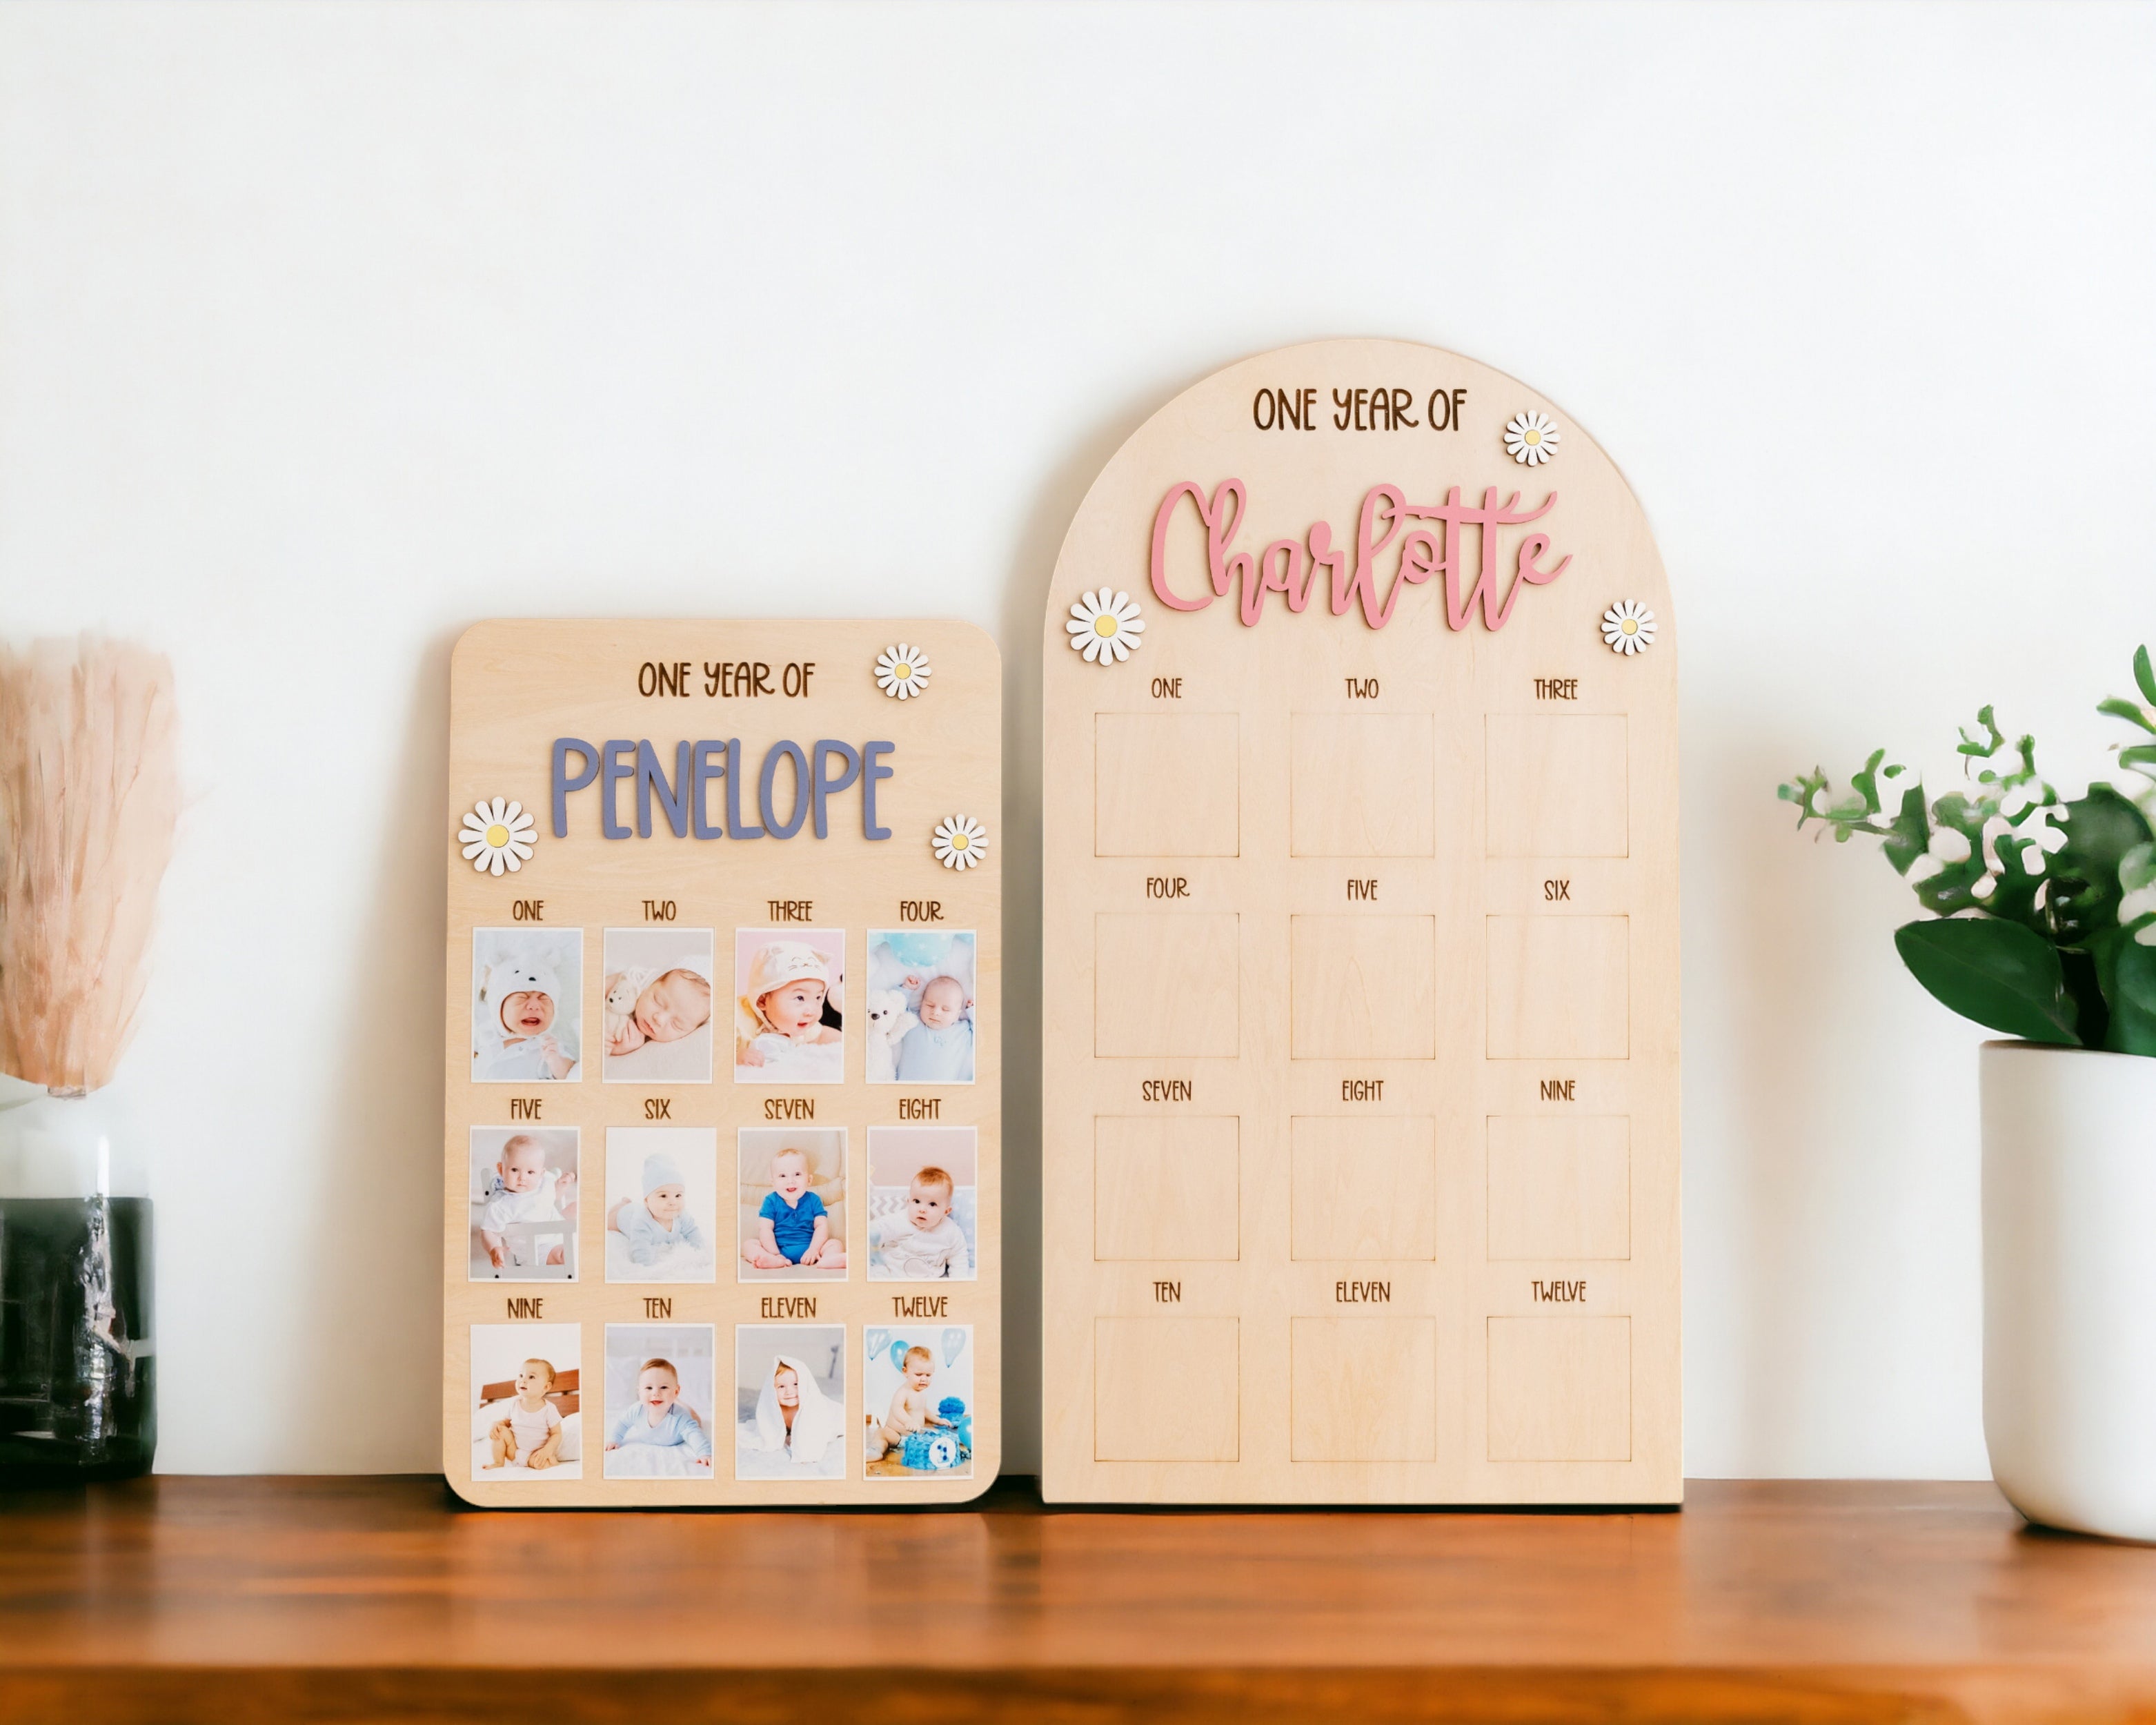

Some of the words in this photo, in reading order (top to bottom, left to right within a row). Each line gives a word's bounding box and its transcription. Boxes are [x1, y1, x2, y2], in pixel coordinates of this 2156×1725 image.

[1253, 388, 1317, 431] ONE
[1332, 387, 1420, 431] YEAR
[1427, 388, 1467, 432] OF
[1150, 477, 1573, 633] Charlotte
[637, 662, 692, 698] ONE
[703, 661, 775, 698] YEAR
[782, 662, 816, 698] OF
[1151, 678, 1183, 699] ONE
[1345, 678, 1379, 699] TWO
[1533, 678, 1579, 700] THREE
[552, 737, 896, 840] PENELOPE
[1147, 877, 1190, 899] FOUR
[1347, 879, 1378, 900] FIVE
[1543, 880, 1570, 901] SIX
[512, 900, 544, 921] ONE
[641, 900, 677, 921] TWO
[767, 900, 813, 922] THREE
[900, 900, 945, 922] FOUR
[1142, 1080, 1191, 1102] SEVEN
[1342, 1080, 1384, 1101] EIGHT
[1540, 1080, 1576, 1101] NINE
[511, 1098, 542, 1120] FIVE
[644, 1098, 671, 1120] SIX
[764, 1098, 815, 1120] SEVEN
[899, 1098, 942, 1120] EIGHT
[1152, 1281, 1181, 1303] TEN
[1336, 1281, 1391, 1303] ELEVEN
[1531, 1280, 1587, 1302] TWELVE
[507, 1297, 544, 1319] NINE
[642, 1297, 672, 1319] TEN
[761, 1297, 817, 1319] ELEVEN
[891, 1296, 948, 1318] TWELVE
